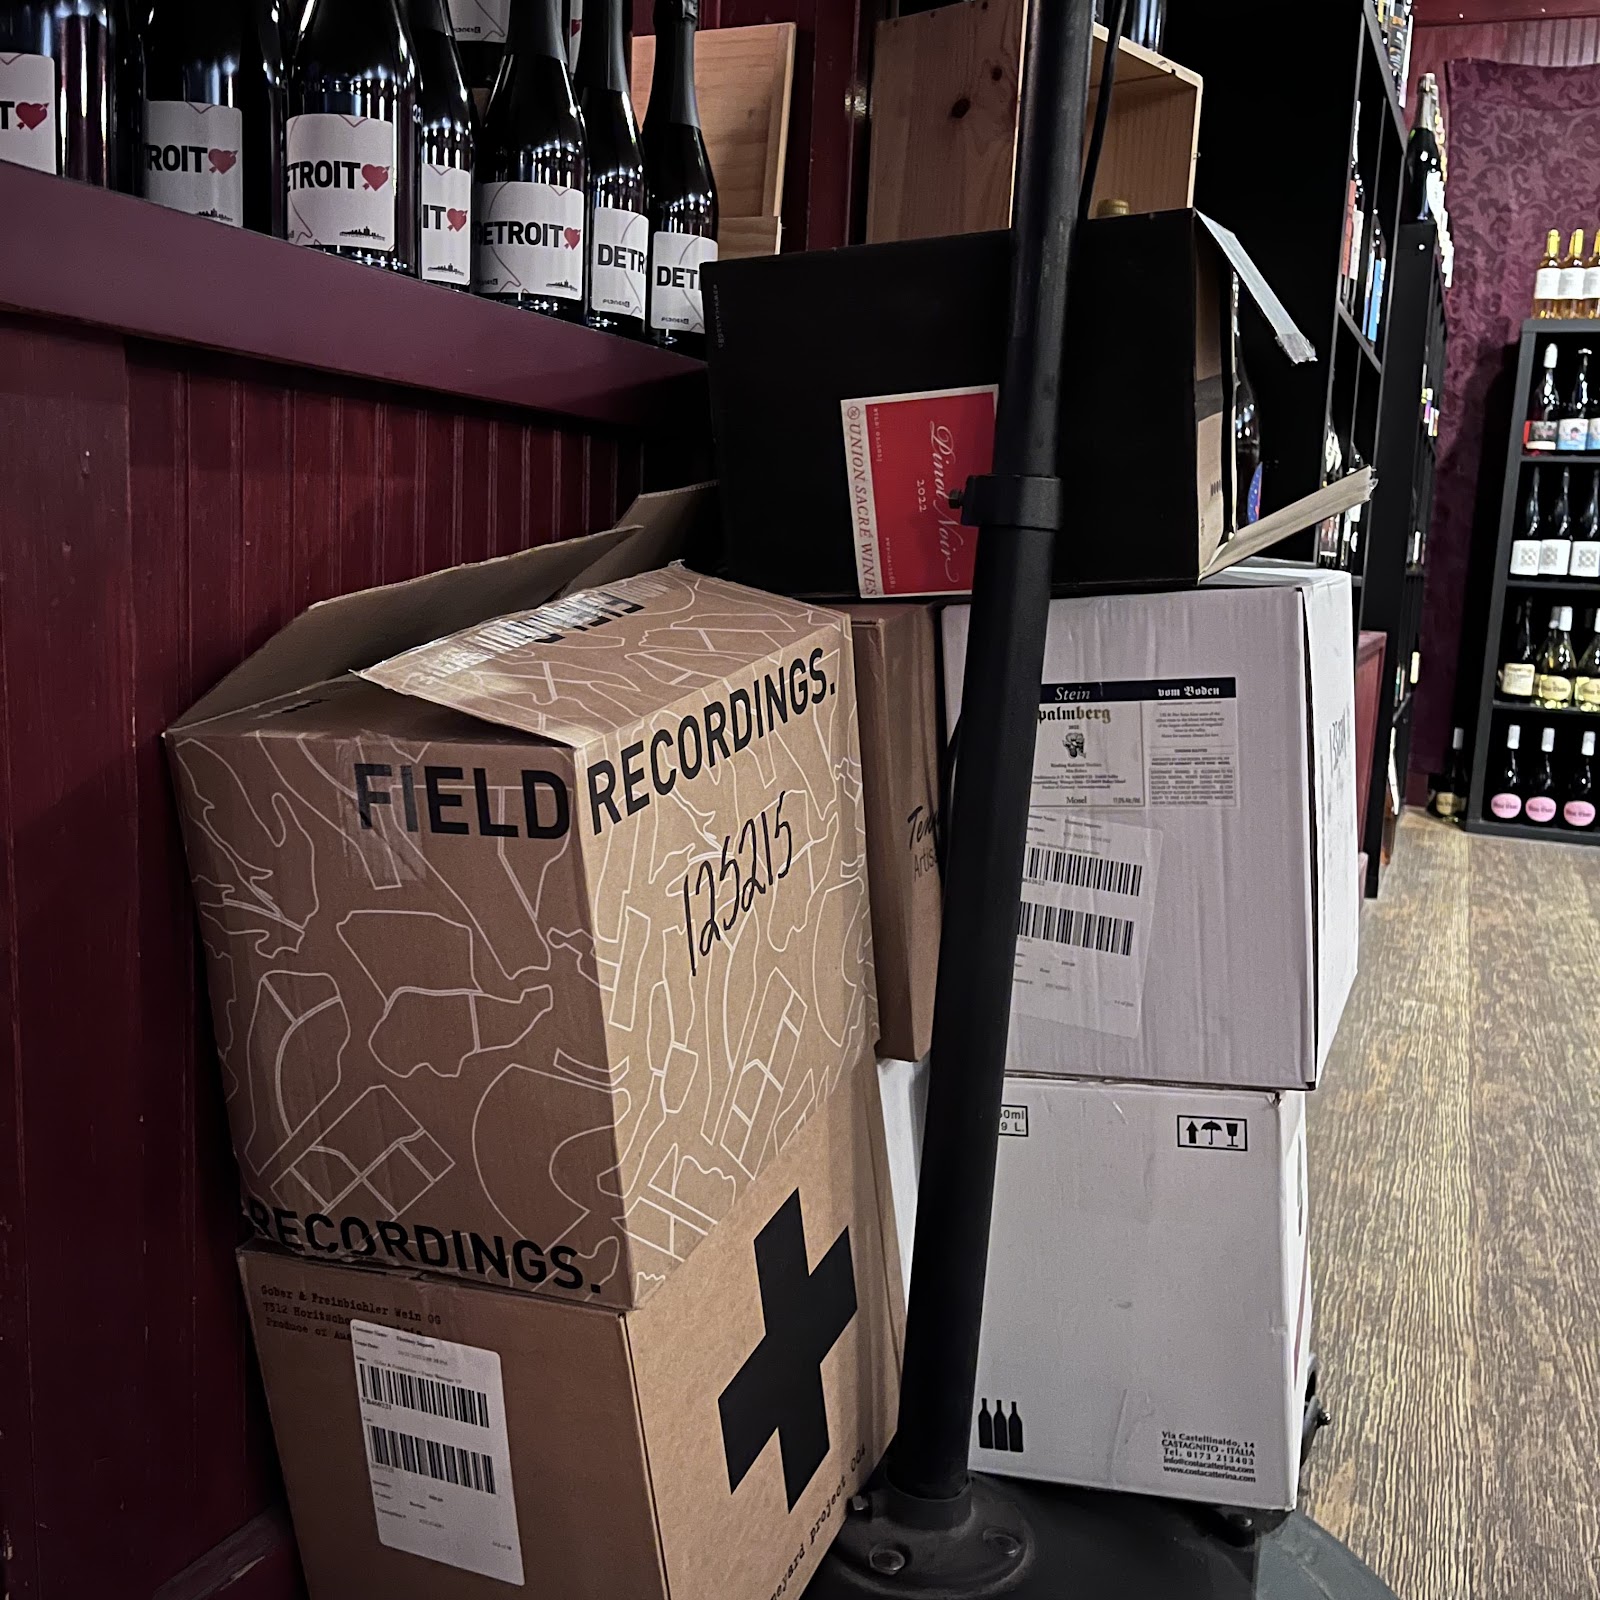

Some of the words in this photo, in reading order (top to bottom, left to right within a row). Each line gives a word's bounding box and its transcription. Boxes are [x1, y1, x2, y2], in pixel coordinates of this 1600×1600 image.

[145, 144, 208, 173] ROIT
[656, 265, 701, 290] DET
[929, 420, 956, 500] Pinot
[848, 422, 866, 480] UNION
[861, 541, 878, 596] WINES
[916, 479, 927, 513] 2022
[1054, 686, 1091, 701] Stein
[1157, 688, 1181, 697] vom
[587, 647, 837, 836] RECORDINGS.
[354, 763, 571, 840] FIELD
[1066, 796, 1087, 804] Mosel
[682, 791, 793, 977] 125215
[248, 1199, 602, 1294] RECORDINGS.
[261, 1285, 293, 1299] Gober
[299, 1291, 307, 1301] &
[394, 1307, 422, 1322] Wein
[428, 1312, 442, 1325] OG
[293, 1306, 353, 1326] Horitscho
[1161, 1430, 1176, 1440] Via
[1243, 1441, 1255, 1449] 14
[1161, 1439, 1219, 1453] CASTAGNITO
[1226, 1448, 1255, 1457] ITALIA
[1163, 1448, 1182, 1457] Tel.
[1186, 1451, 1212, 1461] 0173
[808, 1474, 847, 1546] project
